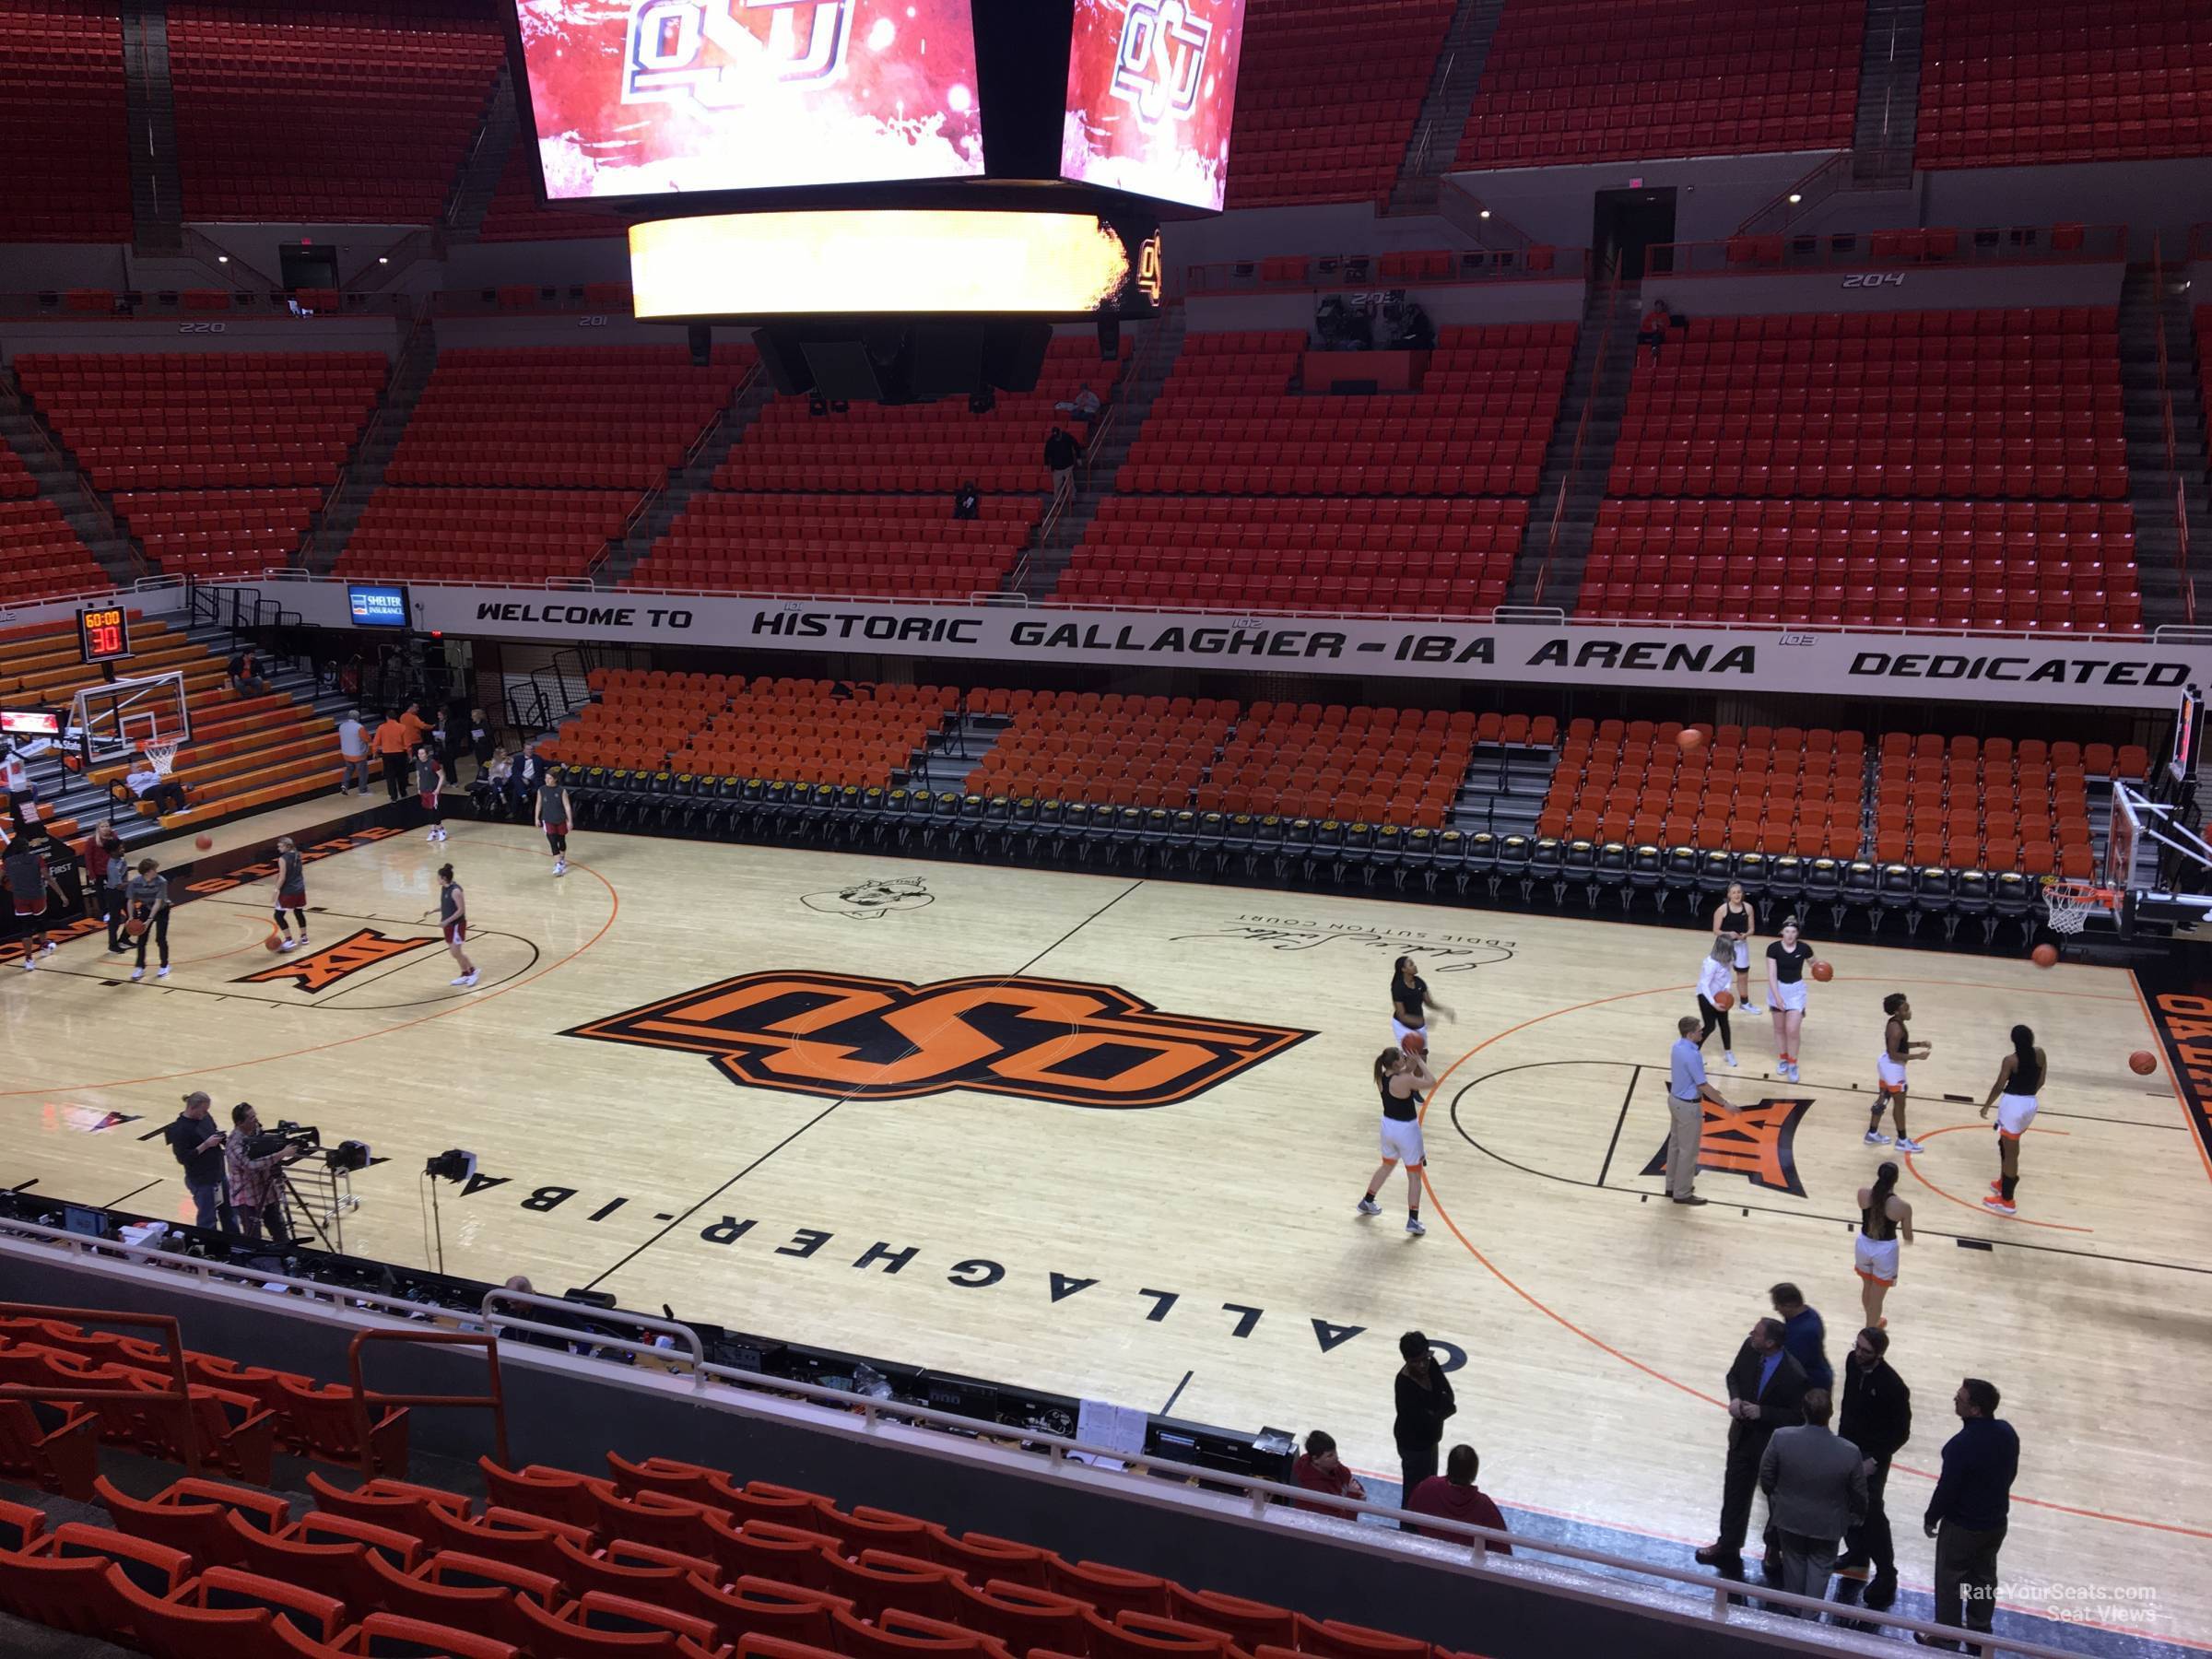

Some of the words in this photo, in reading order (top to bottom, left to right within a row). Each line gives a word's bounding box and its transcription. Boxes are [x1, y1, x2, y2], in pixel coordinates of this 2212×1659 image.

[1842, 273, 1905, 288] 204
[579, 316, 607, 326] 201
[179, 323, 226, 333] 220
[367, 595, 402, 607] SHELTER
[86, 611, 120, 629] 60:00
[1232, 618, 1263, 629] 102
[92, 626, 120, 653] 30
[477, 603, 635, 627] WELCOME
[647, 609, 693, 629] TO
[751, 612, 982, 644] HISTORIC
[1526, 640, 1755, 674] ARENA
[1848, 652, 2192, 687] DEDICATED
[1238, 914, 1317, 927] COURT
[1329, 923, 1426, 938] SUTTON
[1442, 935, 1517, 947] EDDIE
